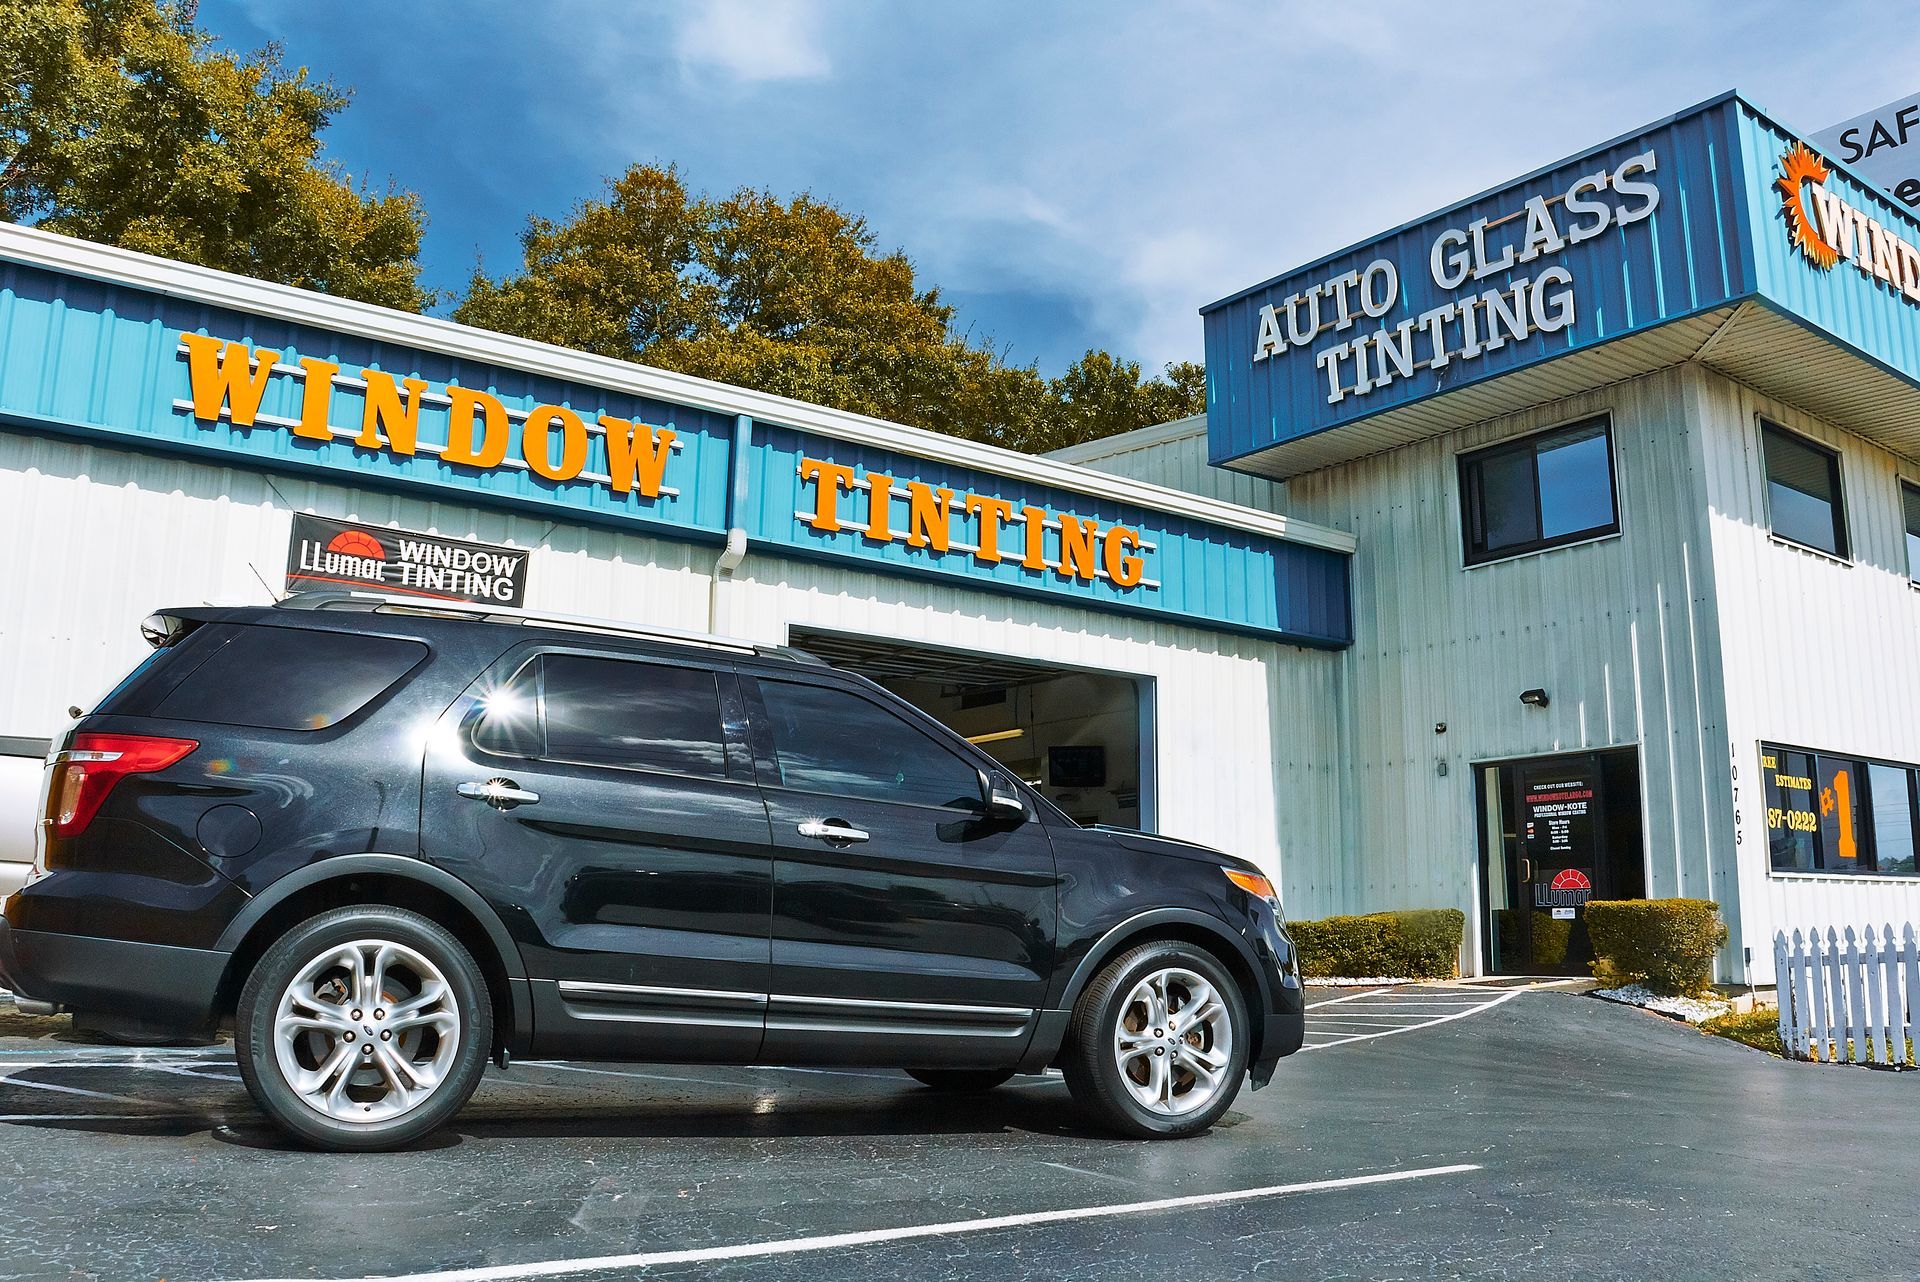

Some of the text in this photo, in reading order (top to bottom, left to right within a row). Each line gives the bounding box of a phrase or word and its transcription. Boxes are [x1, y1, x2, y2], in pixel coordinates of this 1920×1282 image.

[1840, 104, 1920, 164] SAF
[1253, 148, 1661, 362] AUTO GLASS
[1811, 181, 1920, 302] WIND
[1317, 266, 1575, 404] TINTING
[180, 332, 1144, 587] WINDOW TINTING
[300, 539, 386, 582] LLumar
[397, 561, 514, 601] TINTING
[398, 539, 518, 578] WINDOW
[1533, 802, 1588, 813] WINDOW-KOTE
[1731, 742, 1742, 845] 10765
[1775, 774, 1812, 791] ESTIMATES
[1767, 807, 1817, 832] 87-0222
[1820, 770, 1857, 858] #1
[1535, 883, 1591, 907] LLumar
